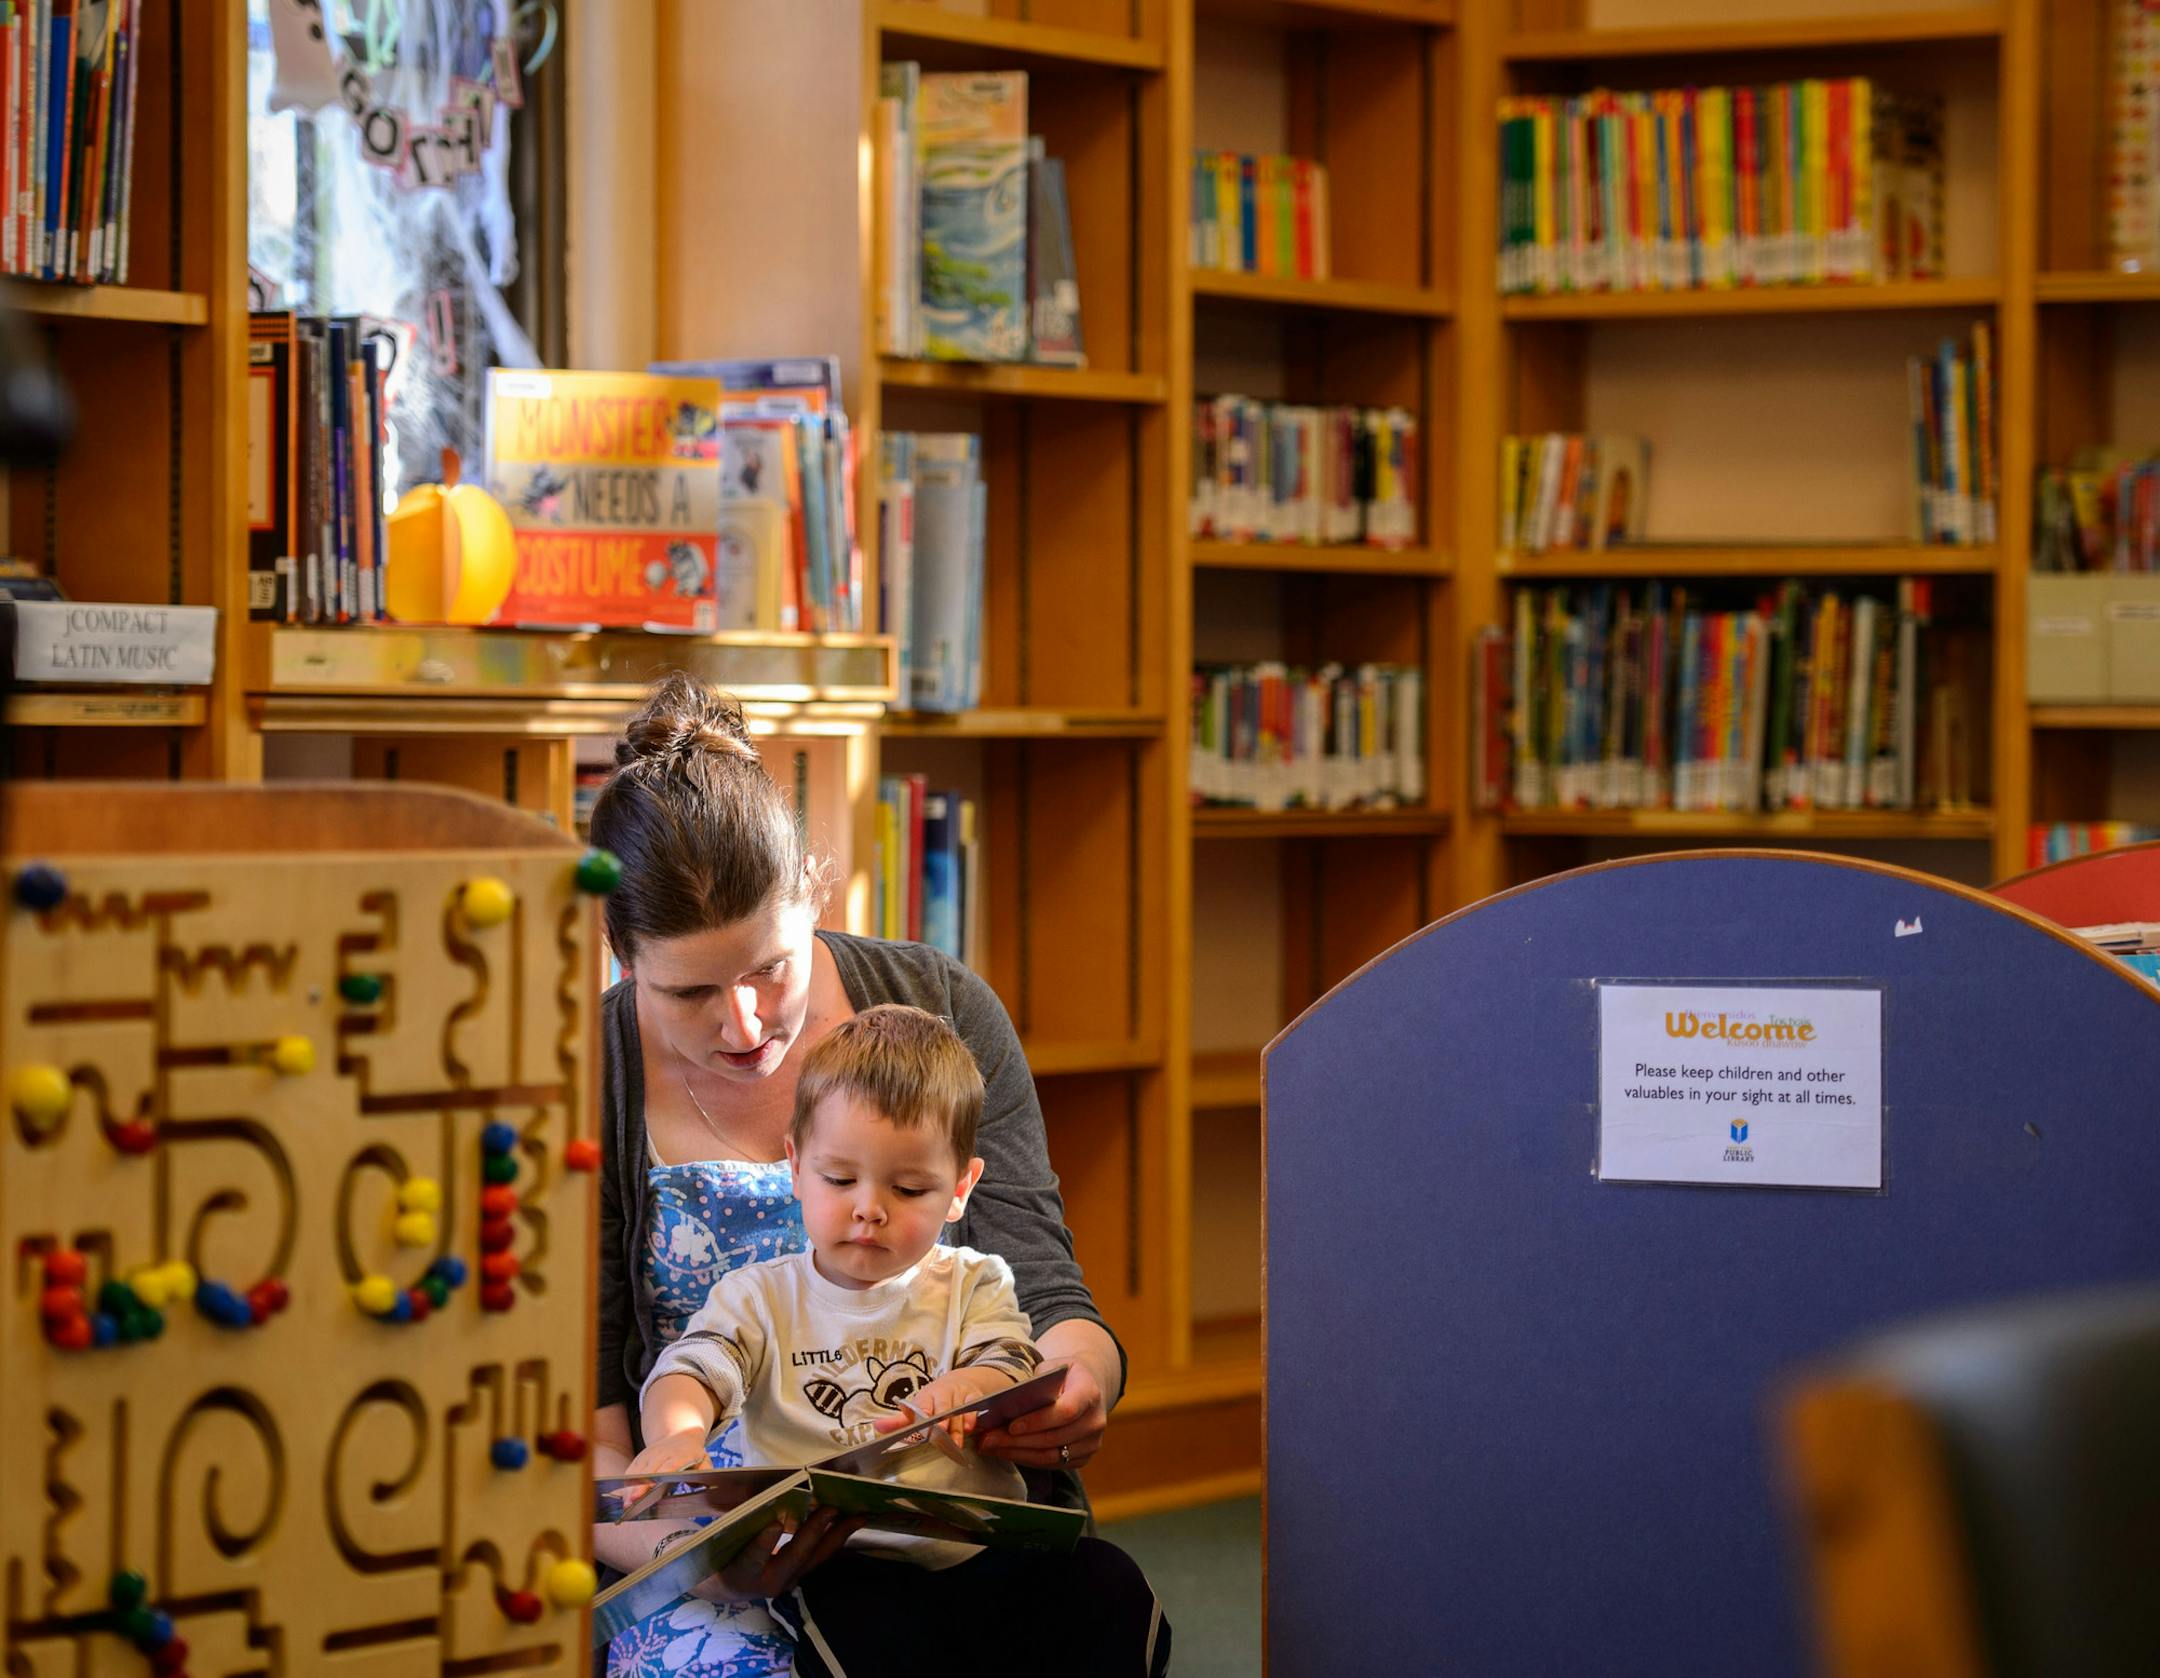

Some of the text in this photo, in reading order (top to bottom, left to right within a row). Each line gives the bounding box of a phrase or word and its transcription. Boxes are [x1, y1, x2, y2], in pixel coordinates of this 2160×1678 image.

[517, 397, 670, 457] MONSTER
[572, 470, 692, 526] NEEDS A
[515, 535, 646, 597] COSTUME
[64, 608, 168, 637] jCOMPACT
[51, 644, 179, 670] LATIN MUSIC
[1665, 1011, 1818, 1041] Welcome
[1635, 1063, 1846, 1082] Please keep children and other
[1624, 1085, 1857, 1106] valuables in your sight at all times.
